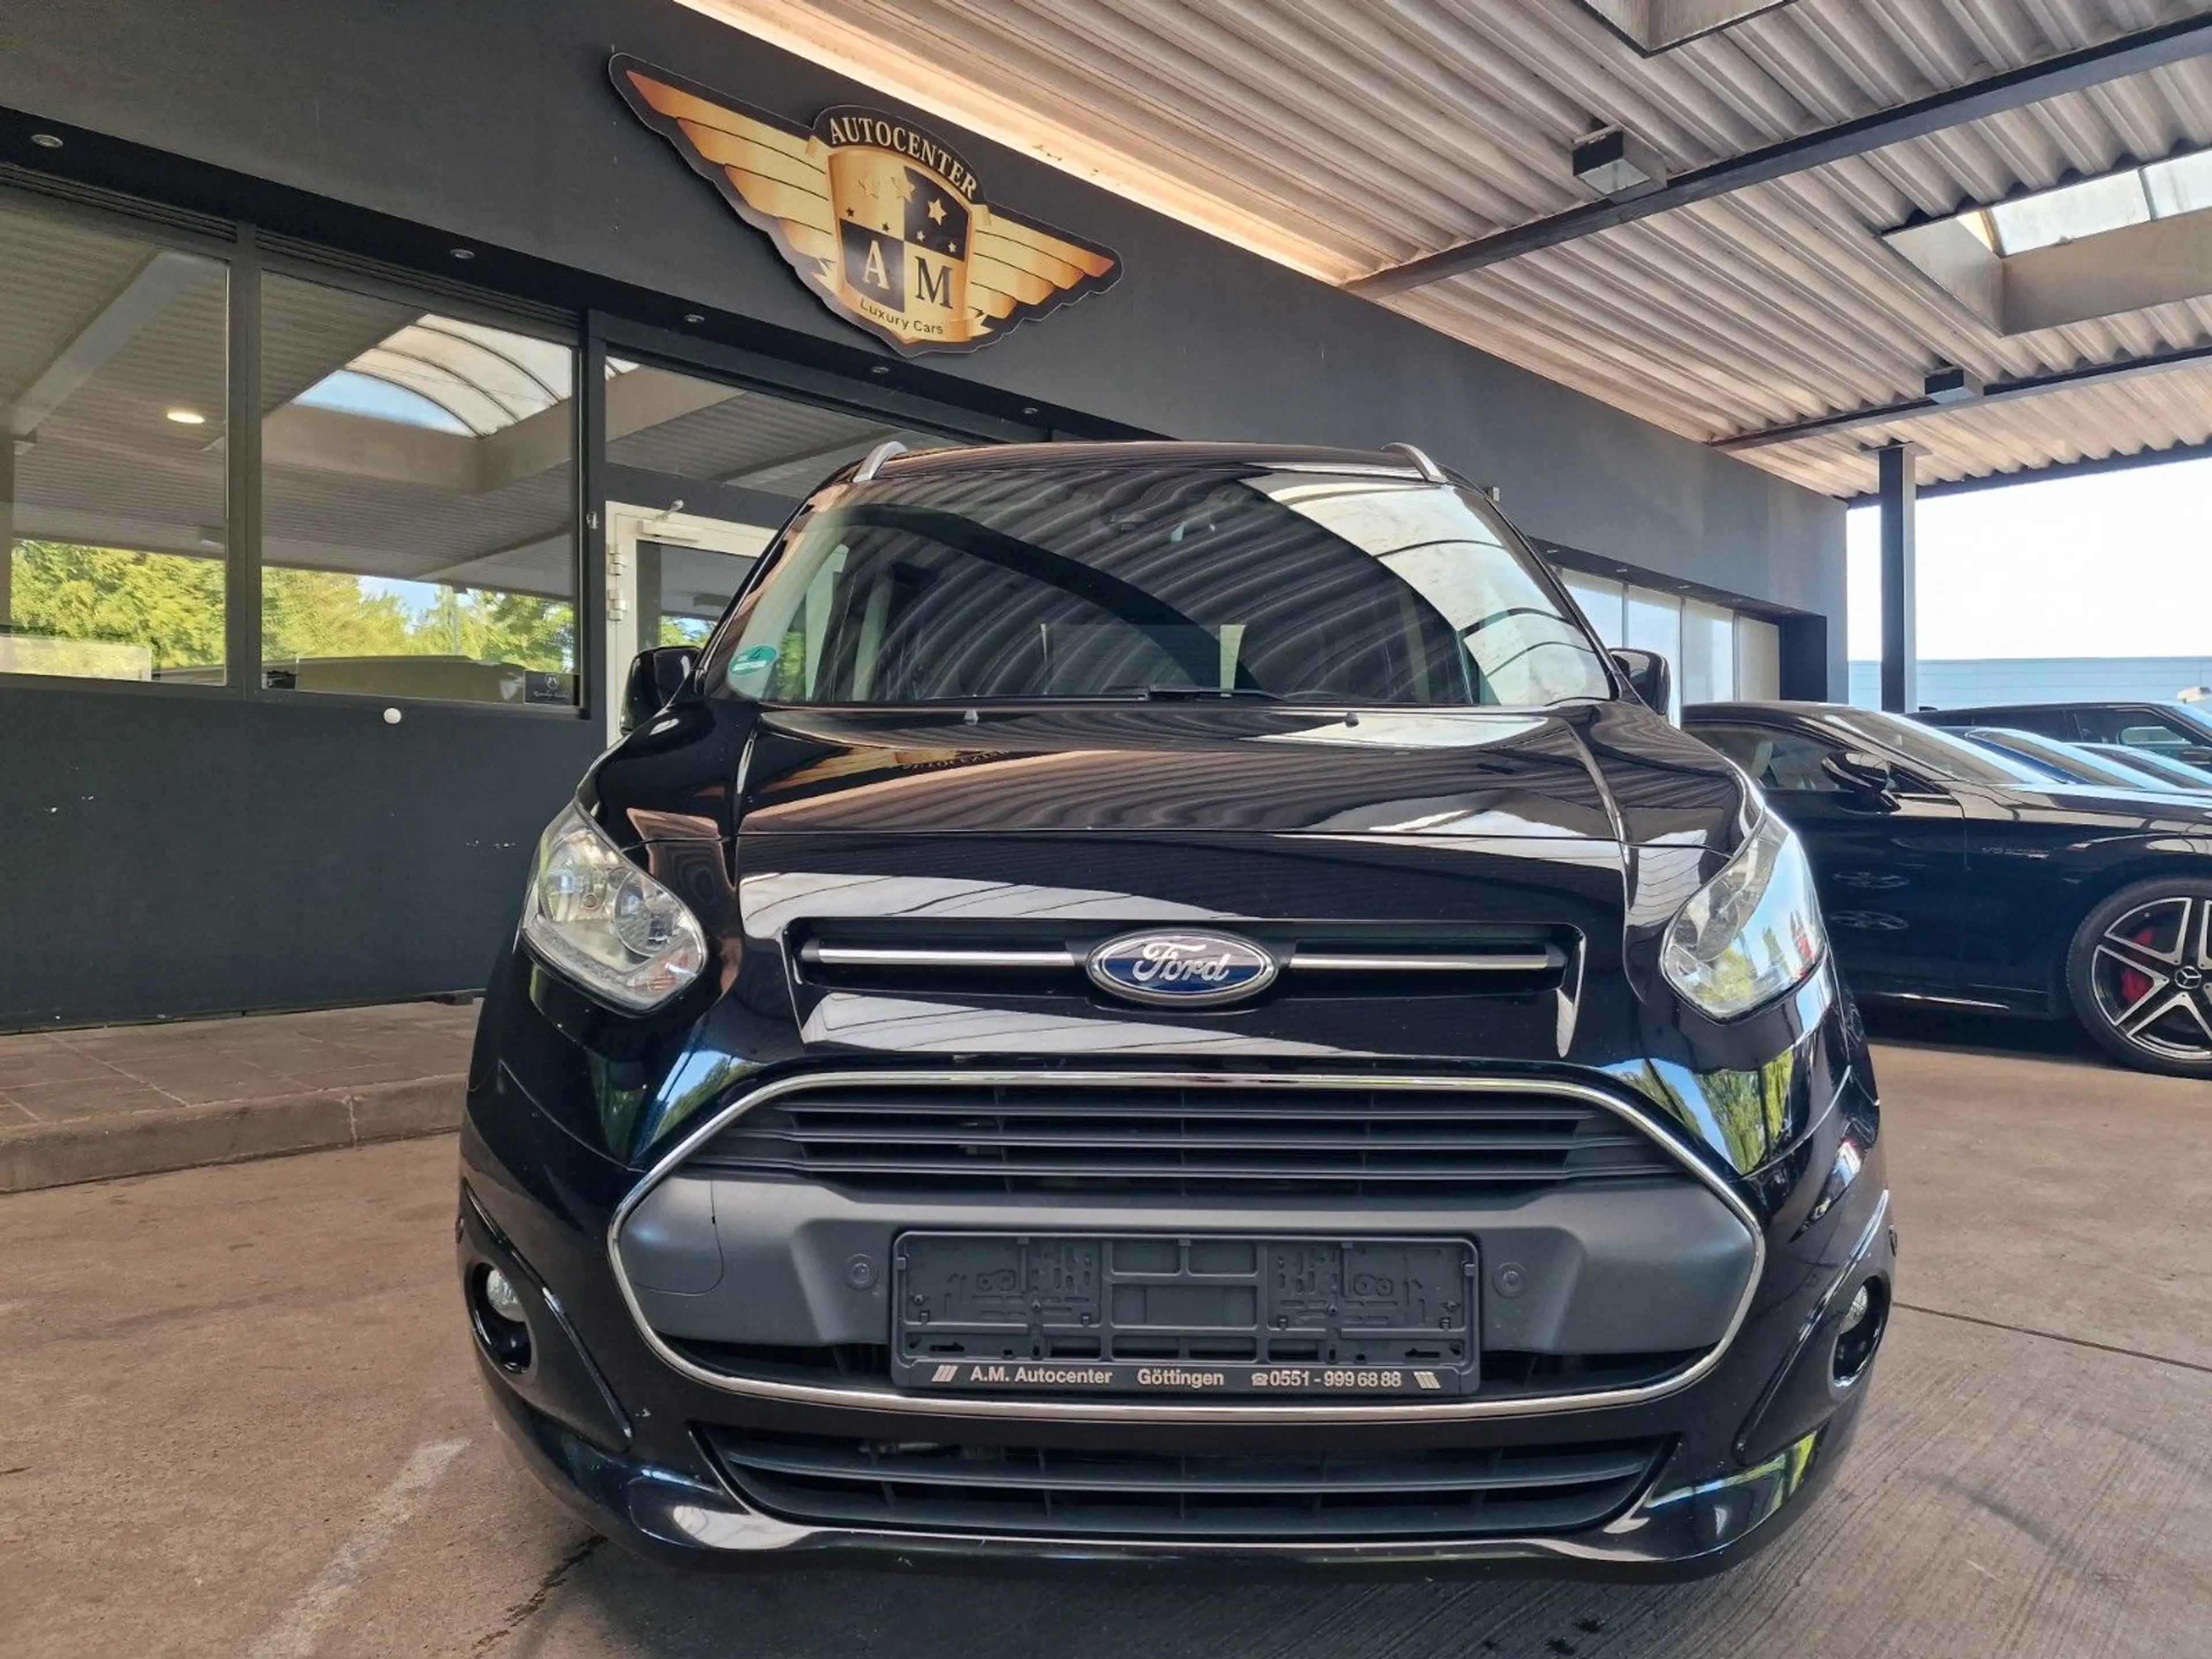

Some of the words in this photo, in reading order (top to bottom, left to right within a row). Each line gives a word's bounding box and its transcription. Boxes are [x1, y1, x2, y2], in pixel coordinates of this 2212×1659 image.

[830, 116, 977, 200] AUTOCENTER
[862, 240, 891, 290] A
[915, 256, 953, 310] M
[860, 297, 909, 331] Luxury
[914, 320, 944, 335] Cars
[1131, 942, 1230, 981] Ford
[970, 1365, 1010, 1382] A.M.
[1014, 1366, 1113, 1383] Autocenter
[1137, 1368, 1224, 1389] Göttingen
